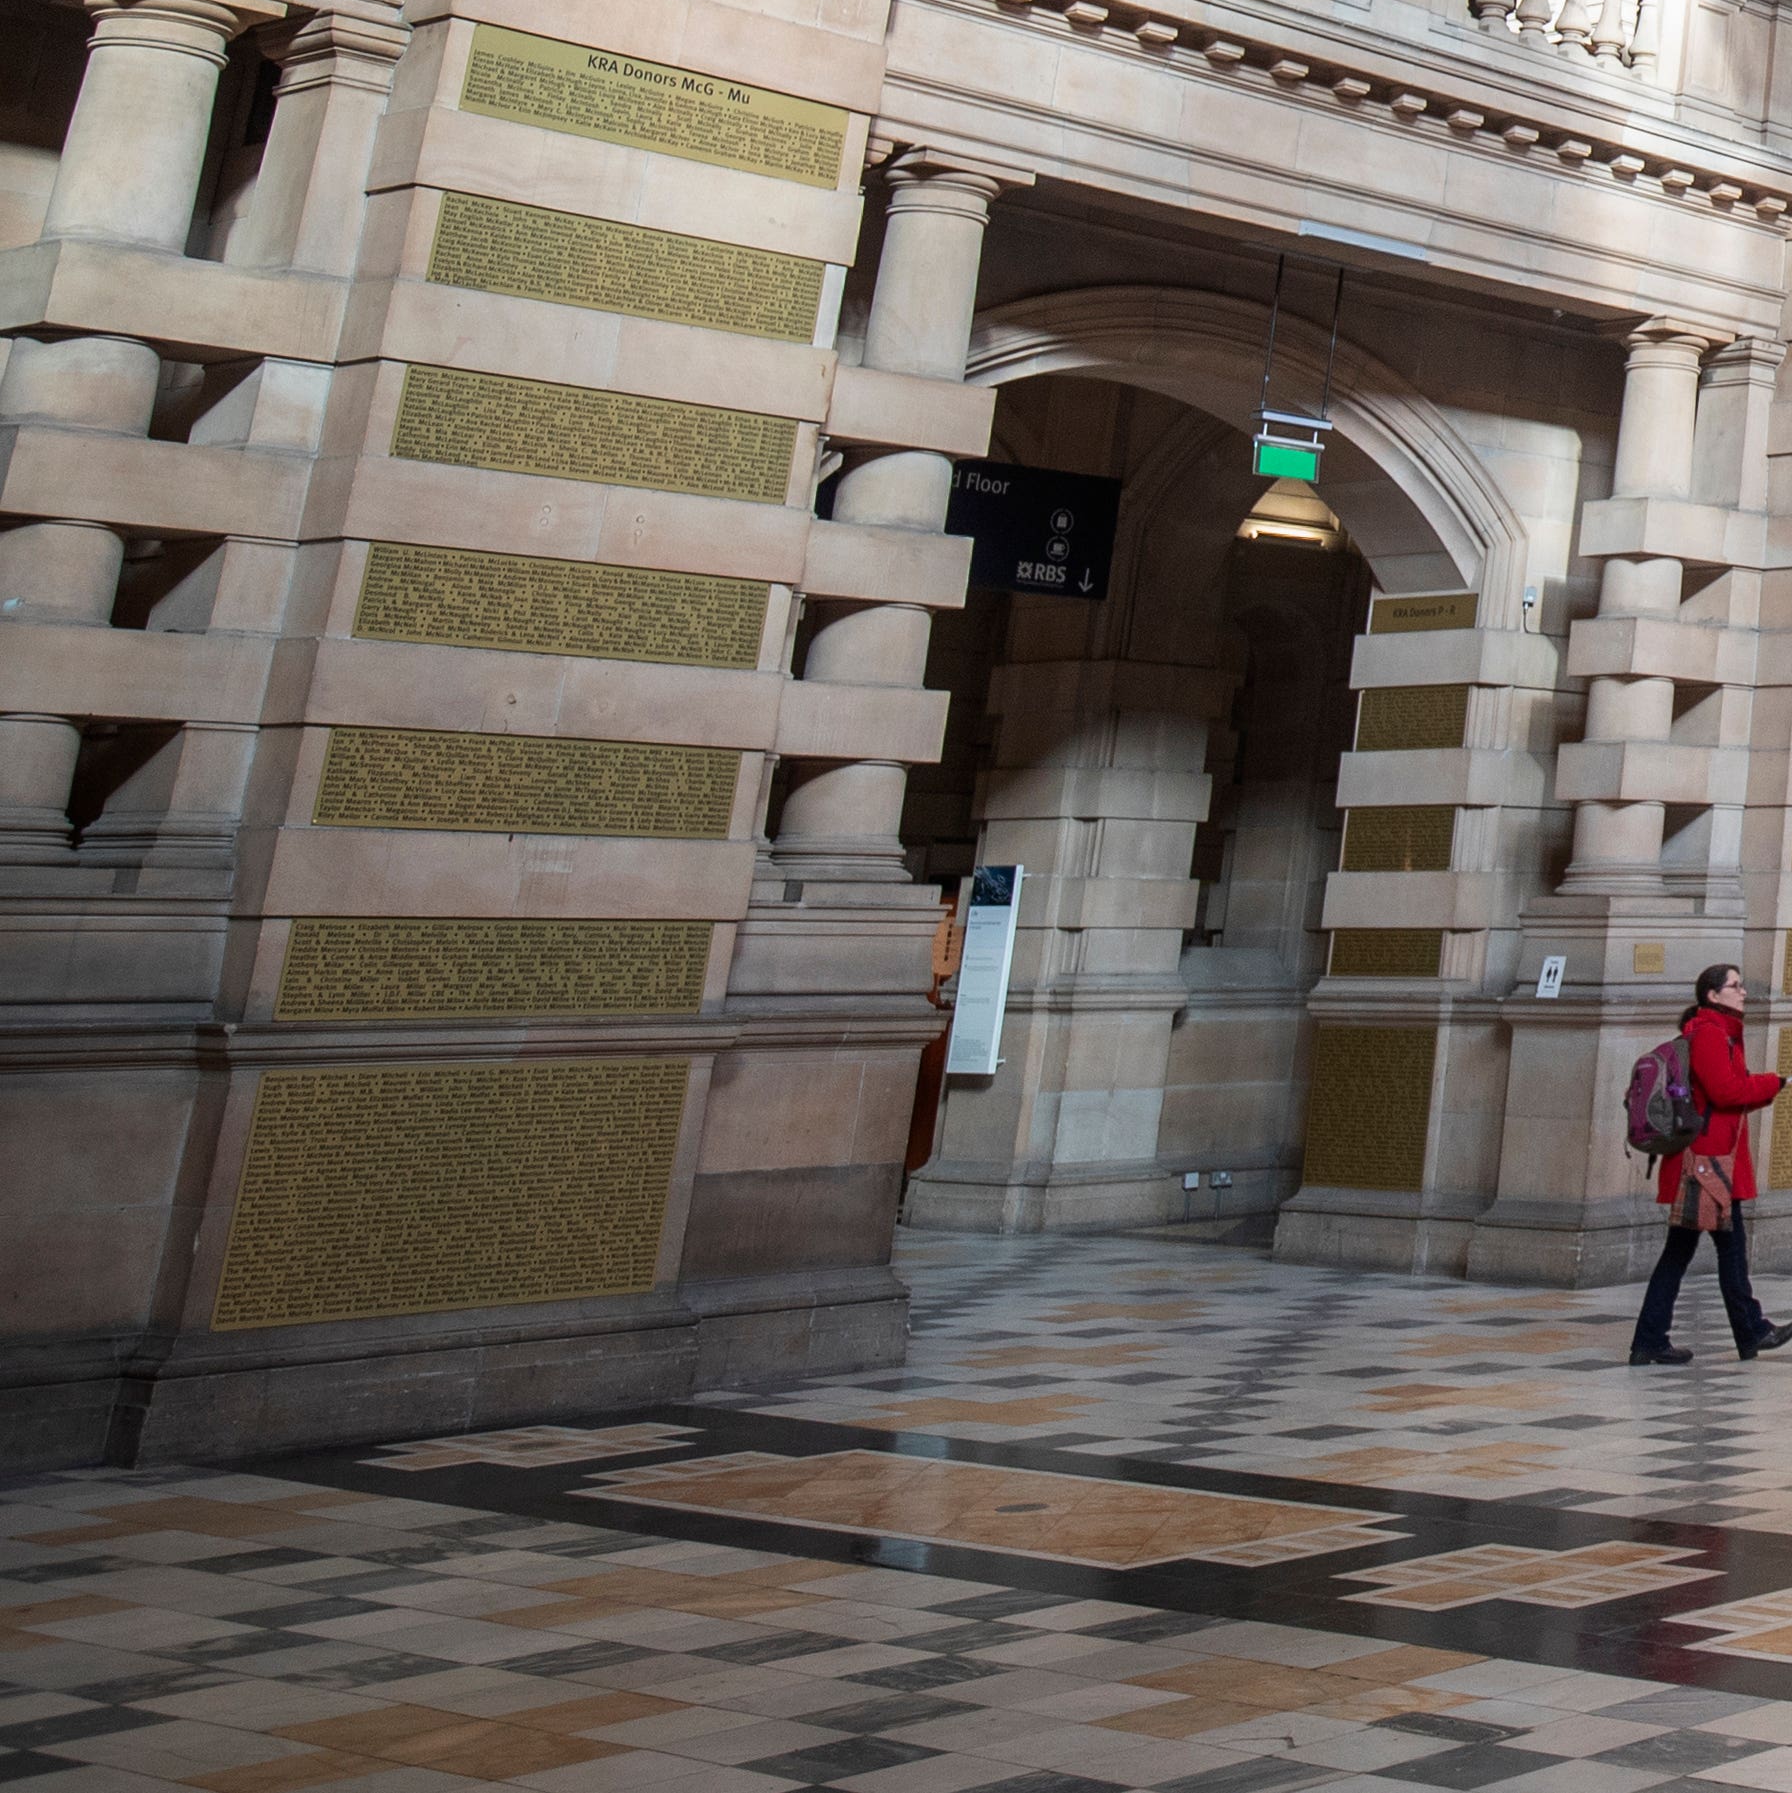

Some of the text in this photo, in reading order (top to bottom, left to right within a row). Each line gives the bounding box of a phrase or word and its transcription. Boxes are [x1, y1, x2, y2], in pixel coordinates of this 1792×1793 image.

[587, 54, 619, 74] KRA
[622, 62, 678, 87] Donors
[681, 76, 715, 96] McG
[727, 87, 751, 104] Mu
[965, 472, 1011, 494] Floor
[1034, 562, 1067, 583] RBS
